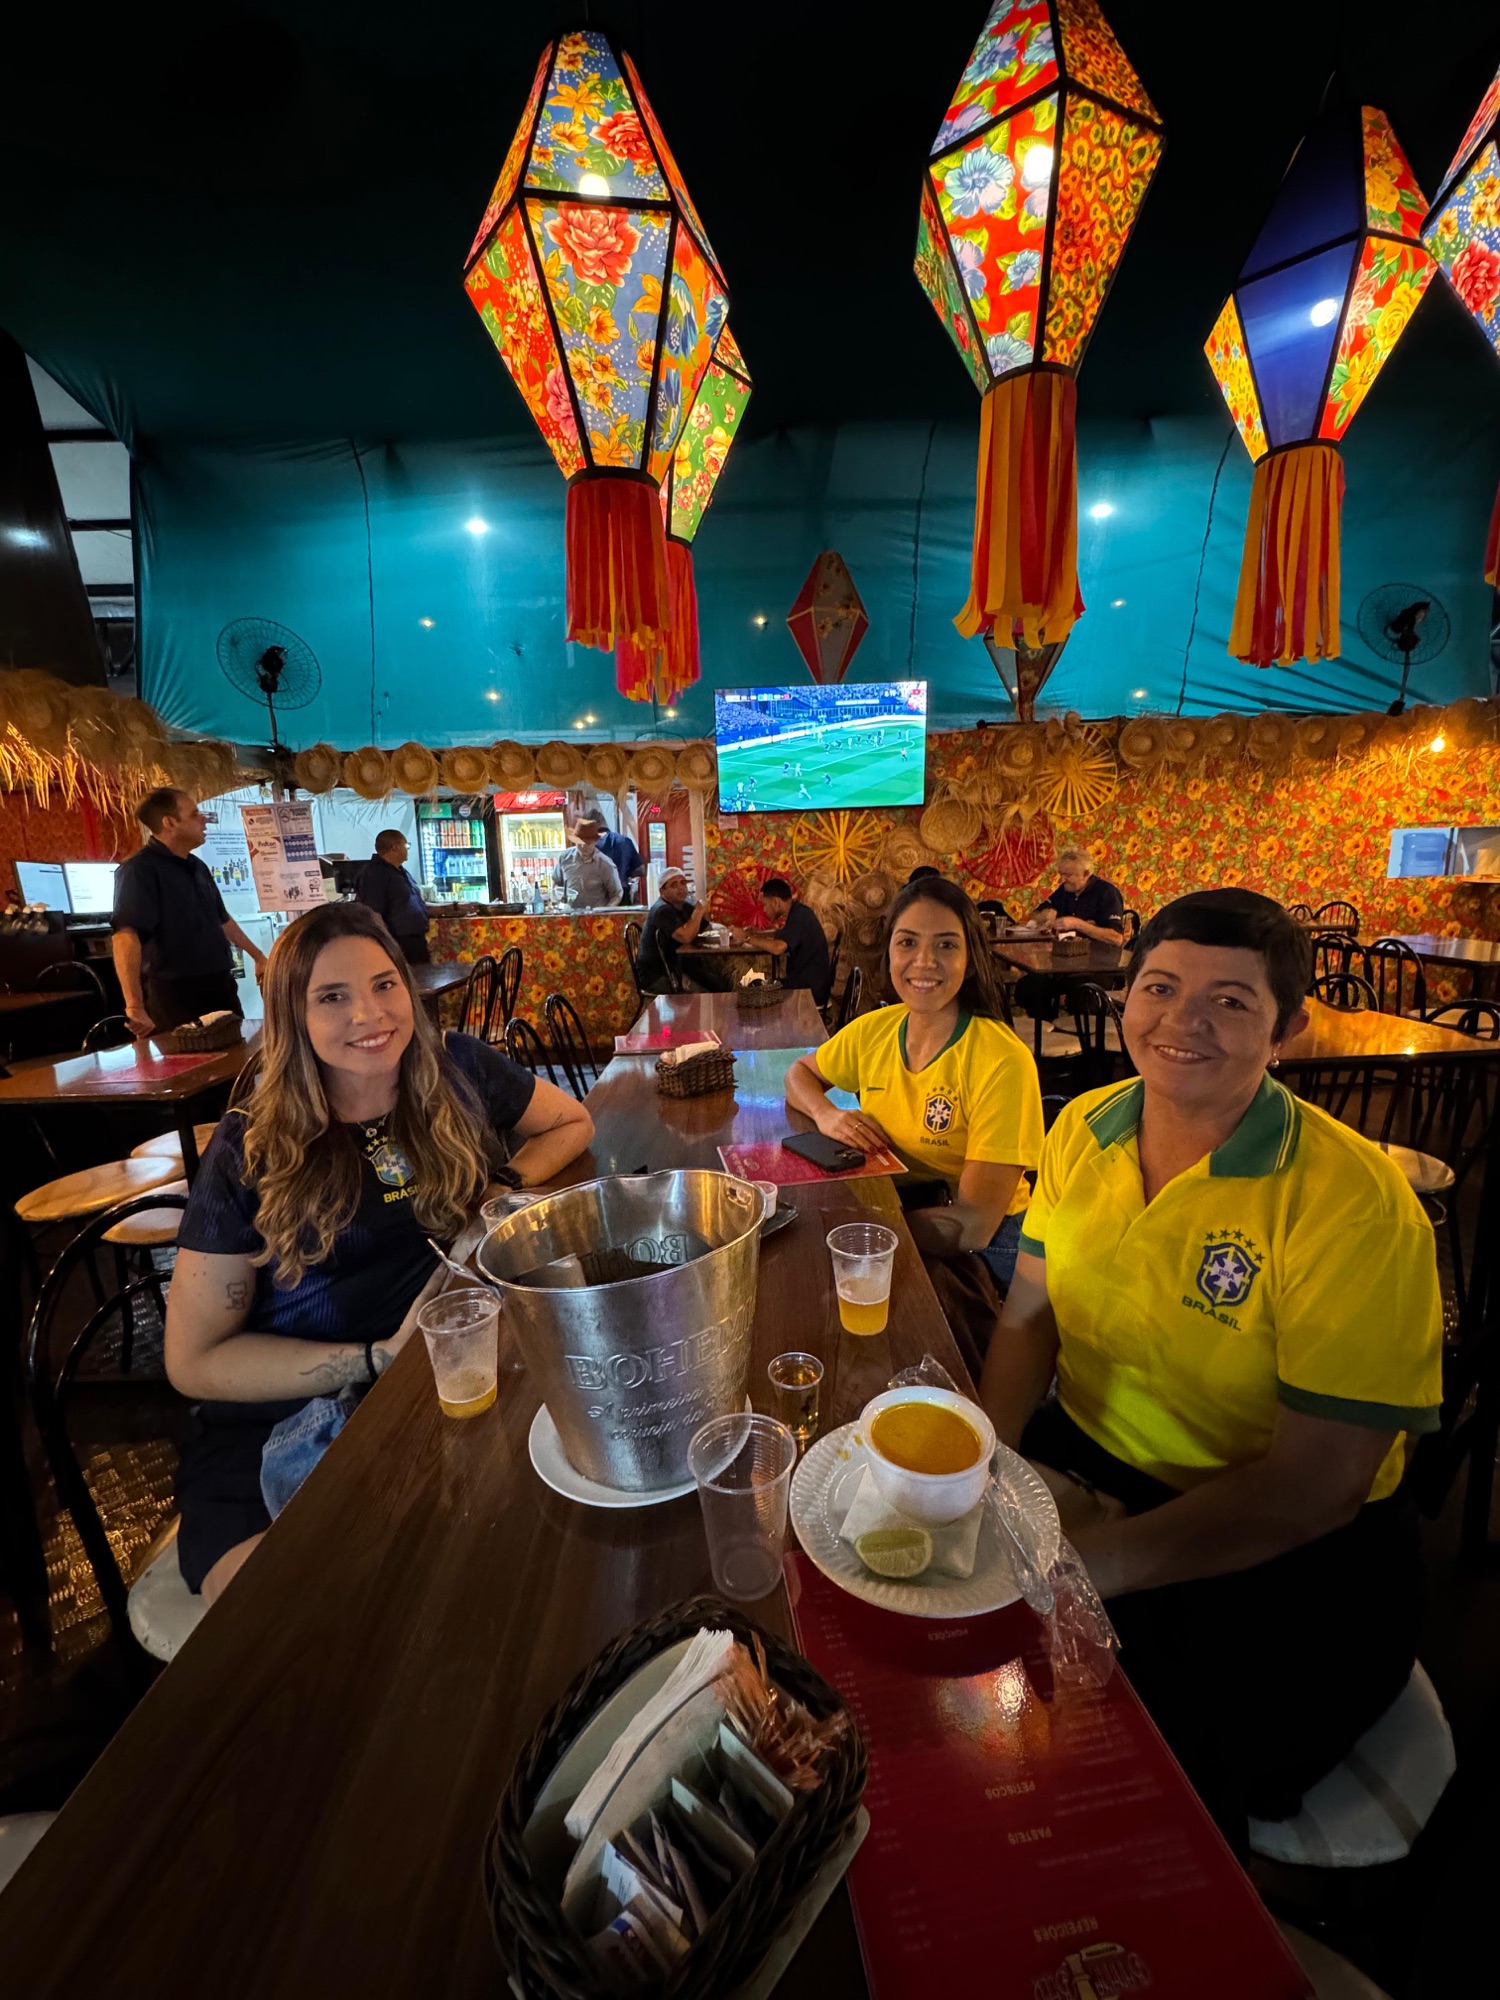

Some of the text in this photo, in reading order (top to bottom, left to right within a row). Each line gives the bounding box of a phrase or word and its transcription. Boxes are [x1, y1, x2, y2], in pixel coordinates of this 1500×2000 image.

[920, 1136, 950, 1147] BRASIL
[383, 1185, 419, 1203] BRASI
[1218, 1268, 1235, 1280] BRA
[1181, 1295, 1241, 1332] BRASIL
[565, 1302, 755, 1390] BOHEM
[985, 1780, 1036, 1800] PETISCOS
